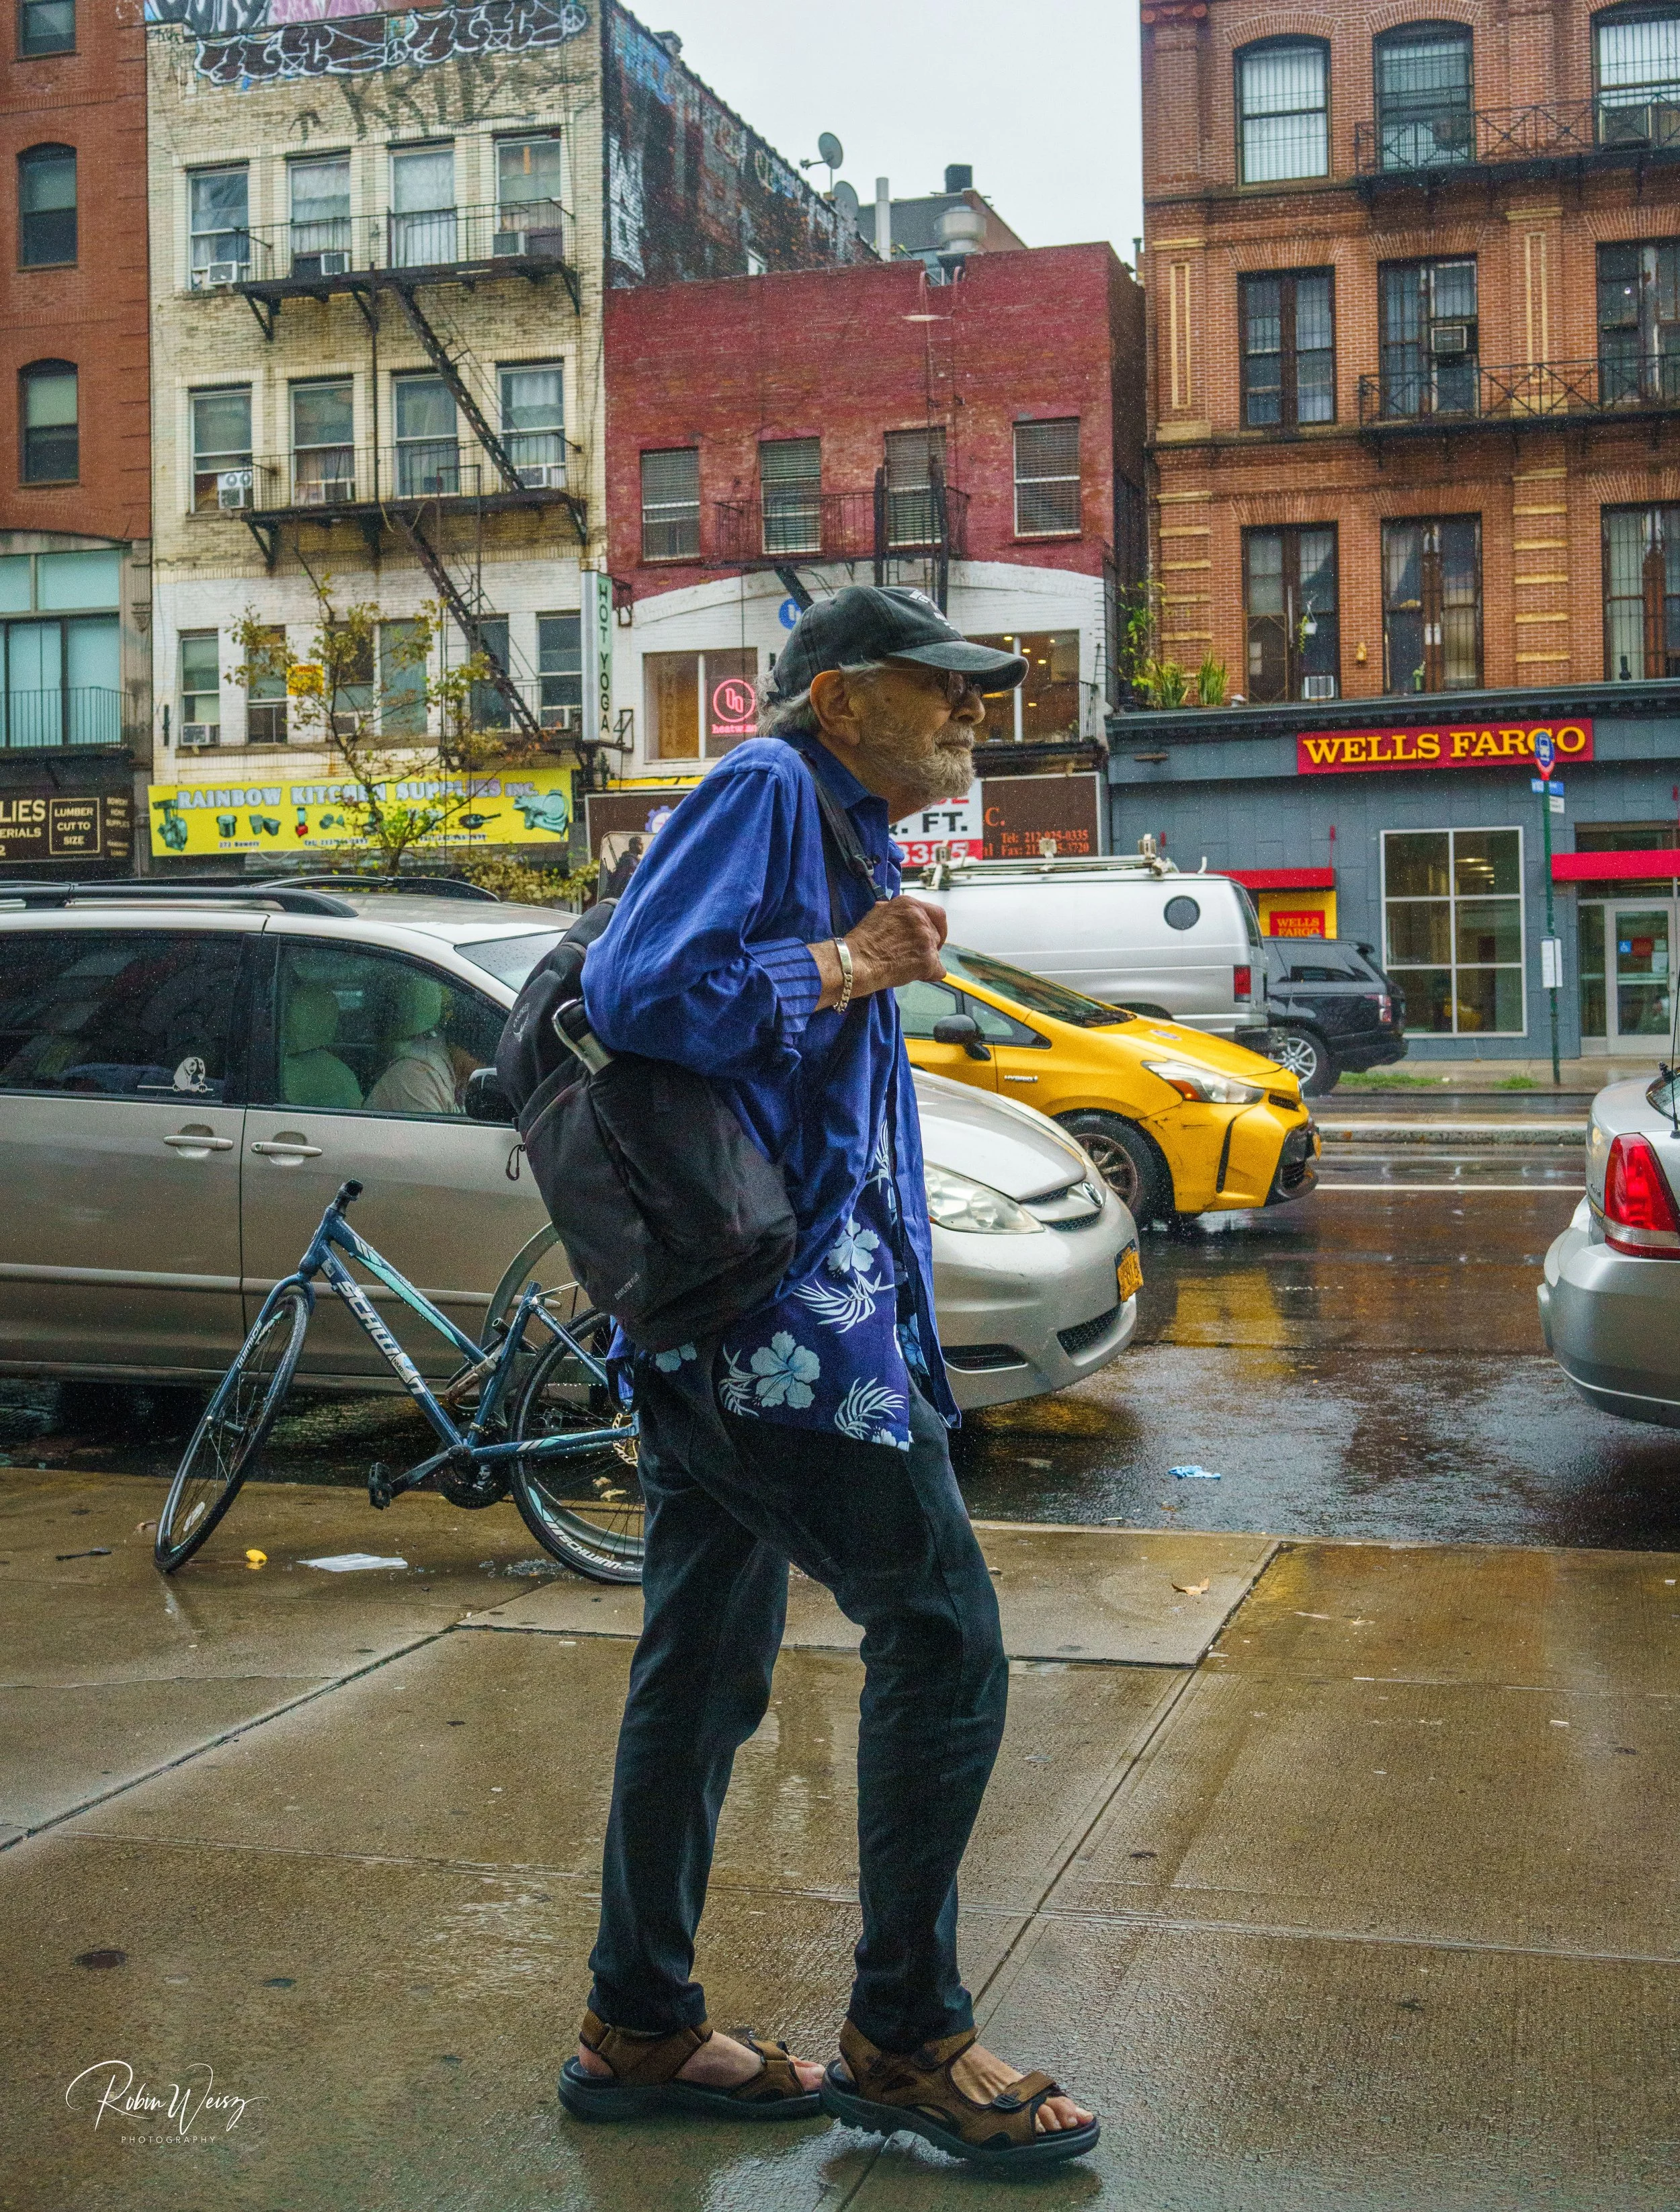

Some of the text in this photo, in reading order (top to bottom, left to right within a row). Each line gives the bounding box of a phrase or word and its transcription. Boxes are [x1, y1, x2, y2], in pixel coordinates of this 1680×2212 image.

[599, 583, 610, 733] HOT YOGA
[1303, 733, 1440, 764] WELLS
[177, 788, 282, 809] RAINBOW
[395, 778, 502, 800] SUPPLIES
[505, 781, 538, 797] INC.
[54, 808, 93, 817] LUMBER
[923, 812, 967, 833] FT.
[56, 822, 91, 831] CUT TO
[64, 836, 85, 845] SIZE
[1277, 917, 1319, 927] WELLS
[558, 1535, 622, 1570] SCHWINN
